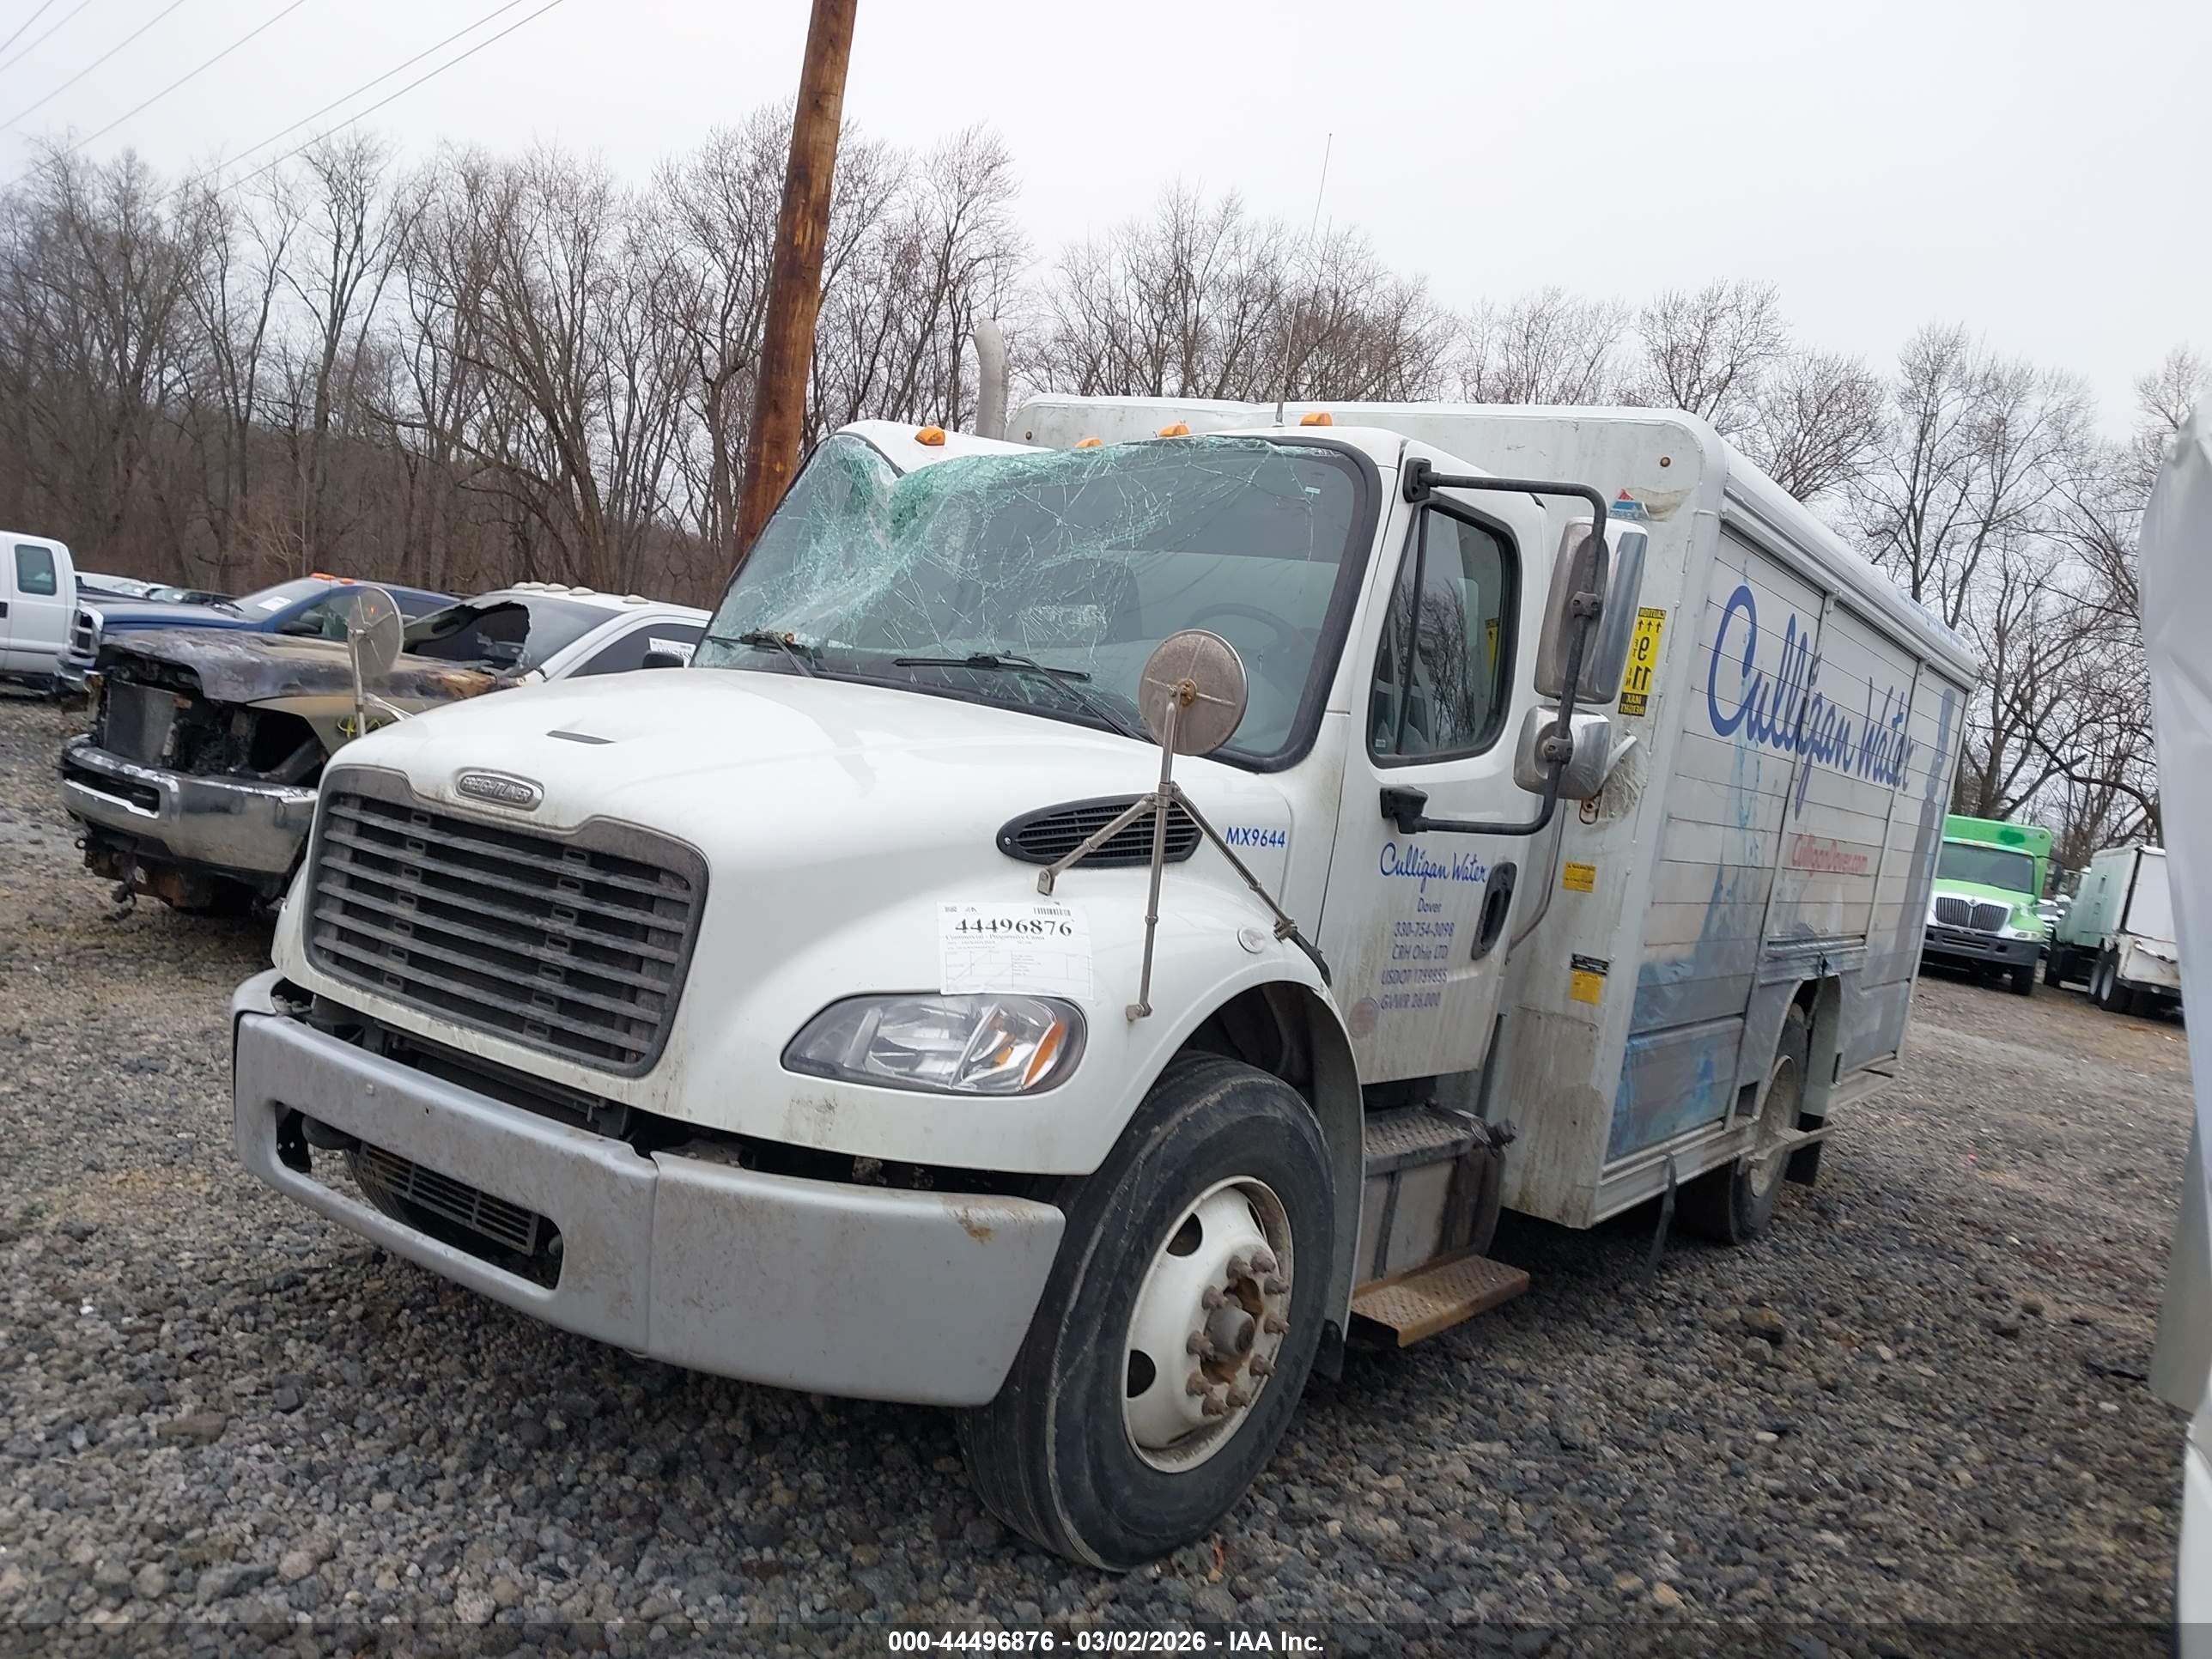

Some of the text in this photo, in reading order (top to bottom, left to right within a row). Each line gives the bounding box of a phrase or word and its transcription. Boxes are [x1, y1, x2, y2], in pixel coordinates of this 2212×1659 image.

[1708, 585, 1913, 821] Culligan Water
[1225, 826, 1286, 848] MX9644
[1380, 842, 1487, 893] Culligan Water
[1417, 897, 1442, 913] Dover
[955, 918, 1072, 936] 44496876
